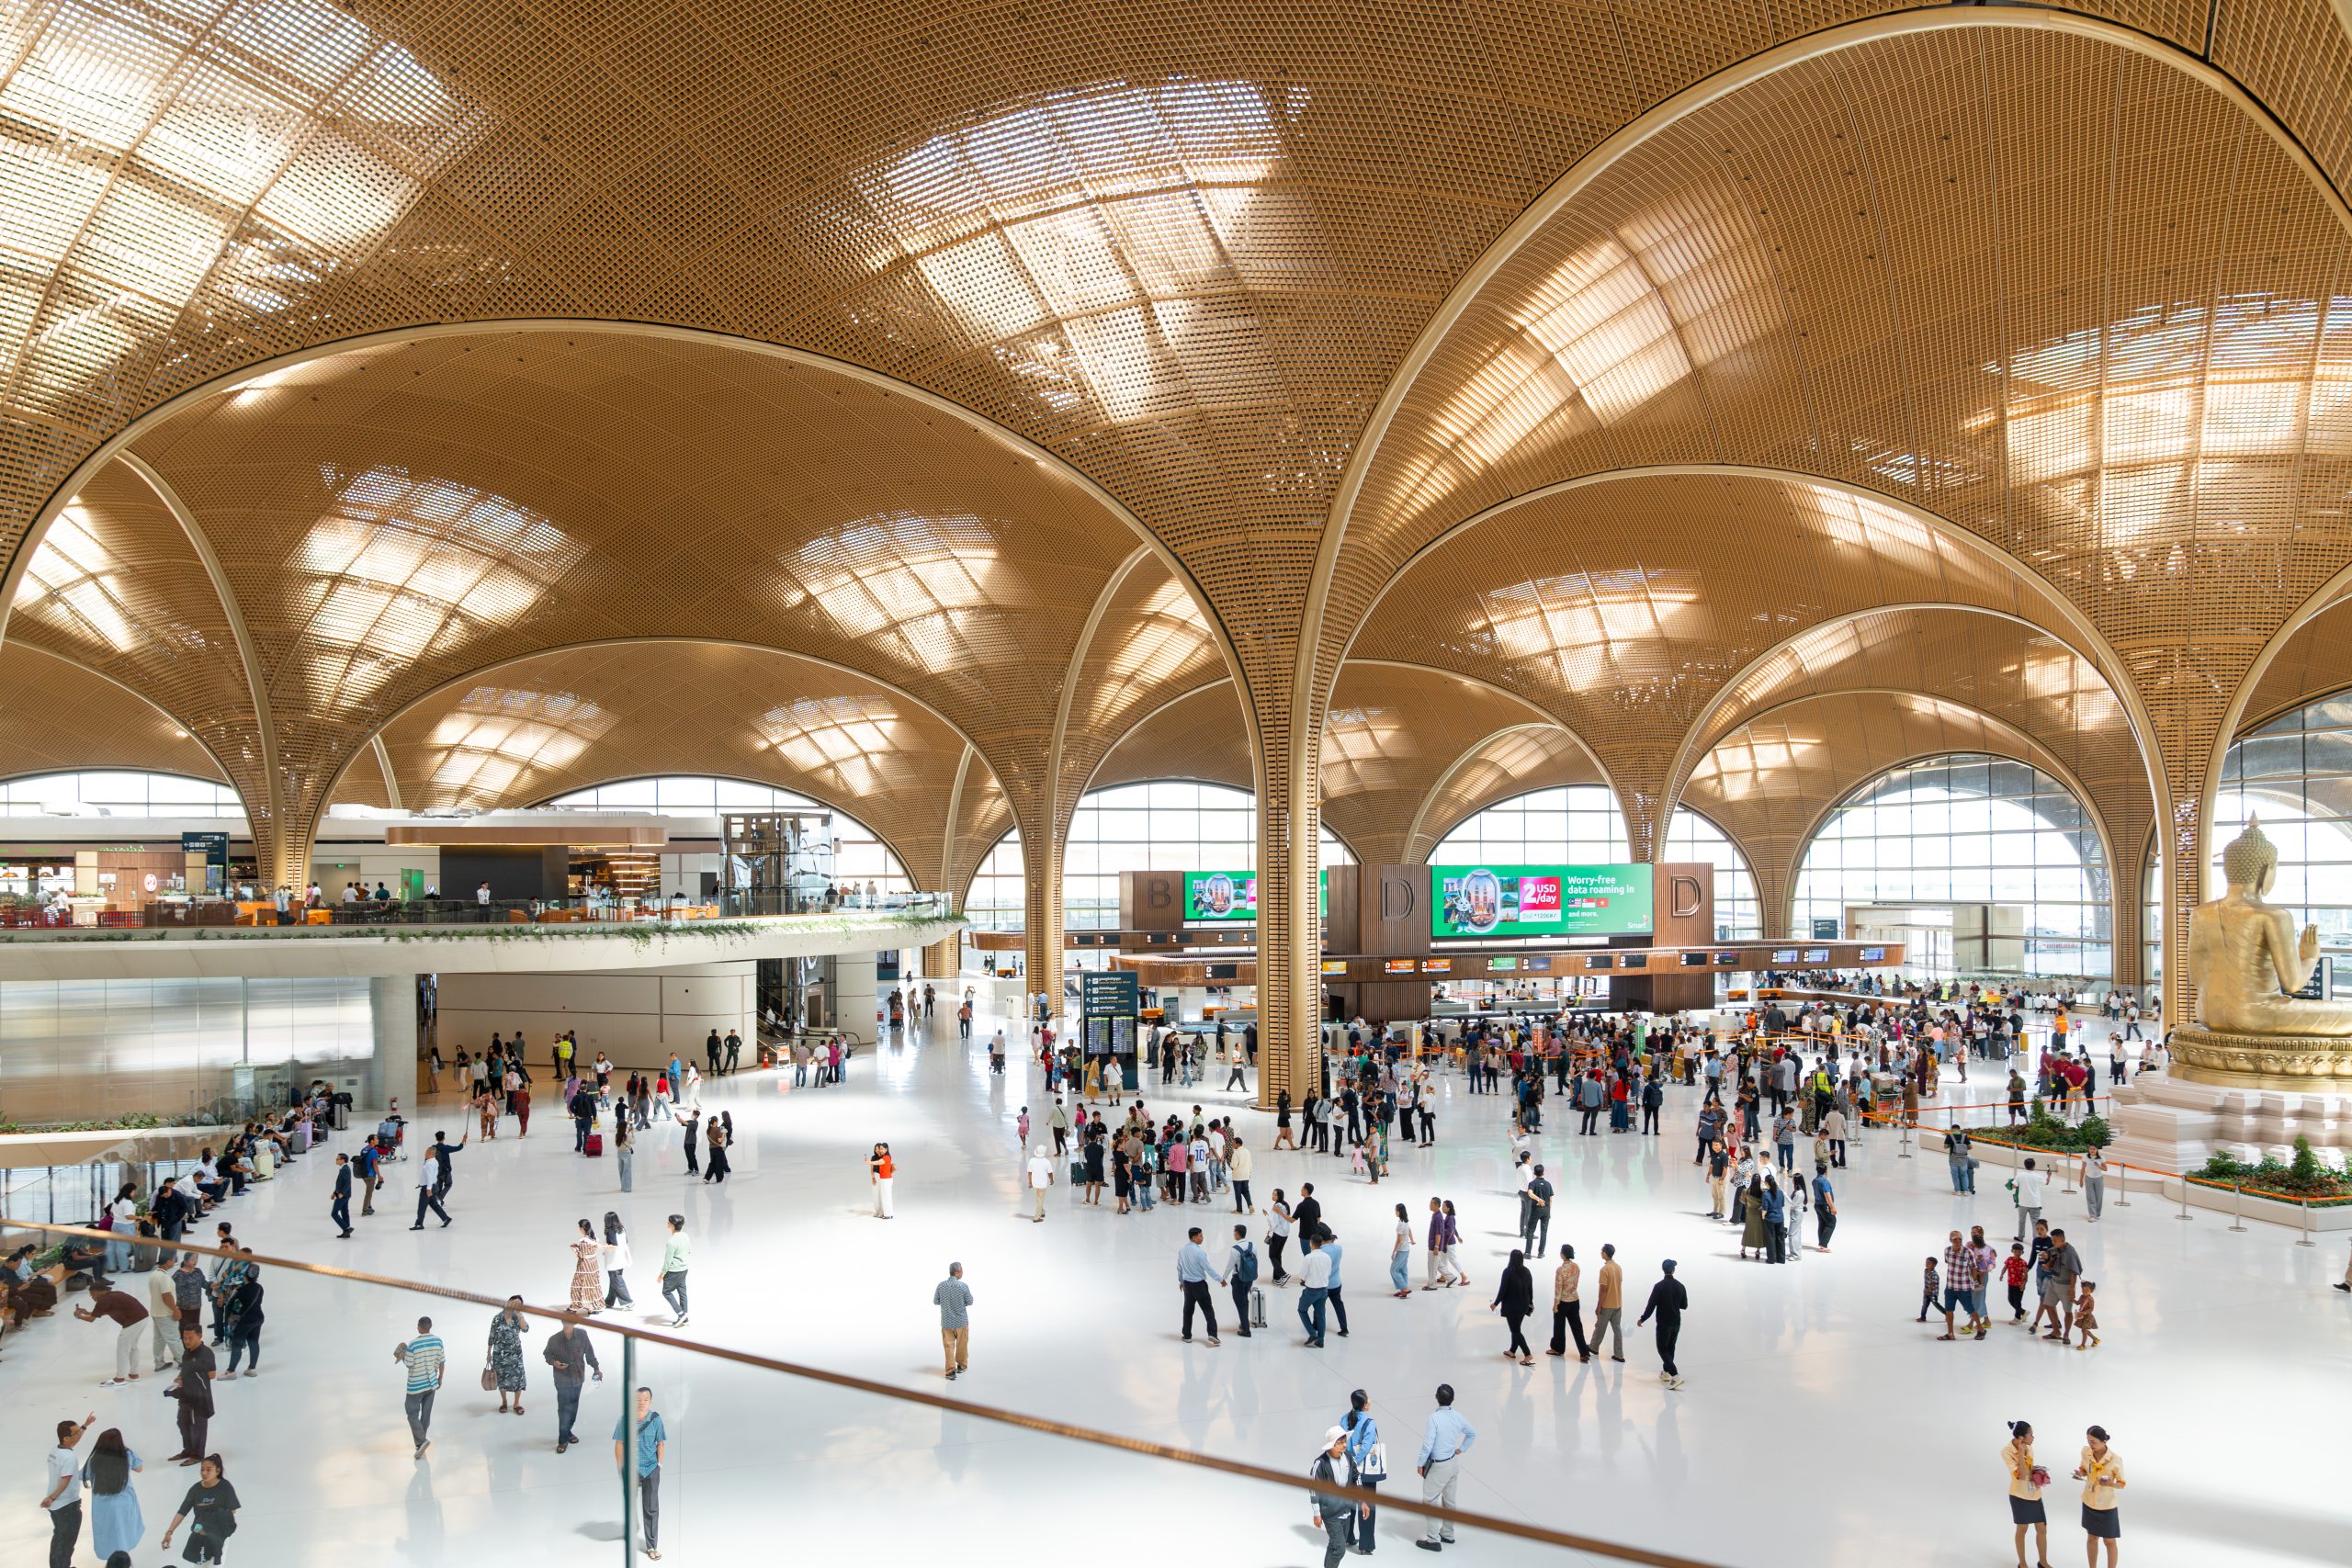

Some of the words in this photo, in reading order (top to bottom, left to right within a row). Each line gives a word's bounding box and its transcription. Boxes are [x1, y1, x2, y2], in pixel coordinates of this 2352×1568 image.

[1567, 875, 1616, 886] Worry-free
[1148, 879, 1170, 908] B
[1382, 878, 1413, 919] D
[1523, 883, 1537, 904] 2
[1536, 884, 1556, 893] USD
[1567, 886, 1588, 894] data
[1589, 885, 1624, 896] roaming
[1626, 885, 1634, 894] in
[1671, 875, 1701, 917] D
[1536, 894, 1556, 904] /day
[1195, 1149, 1204, 1161] 10
